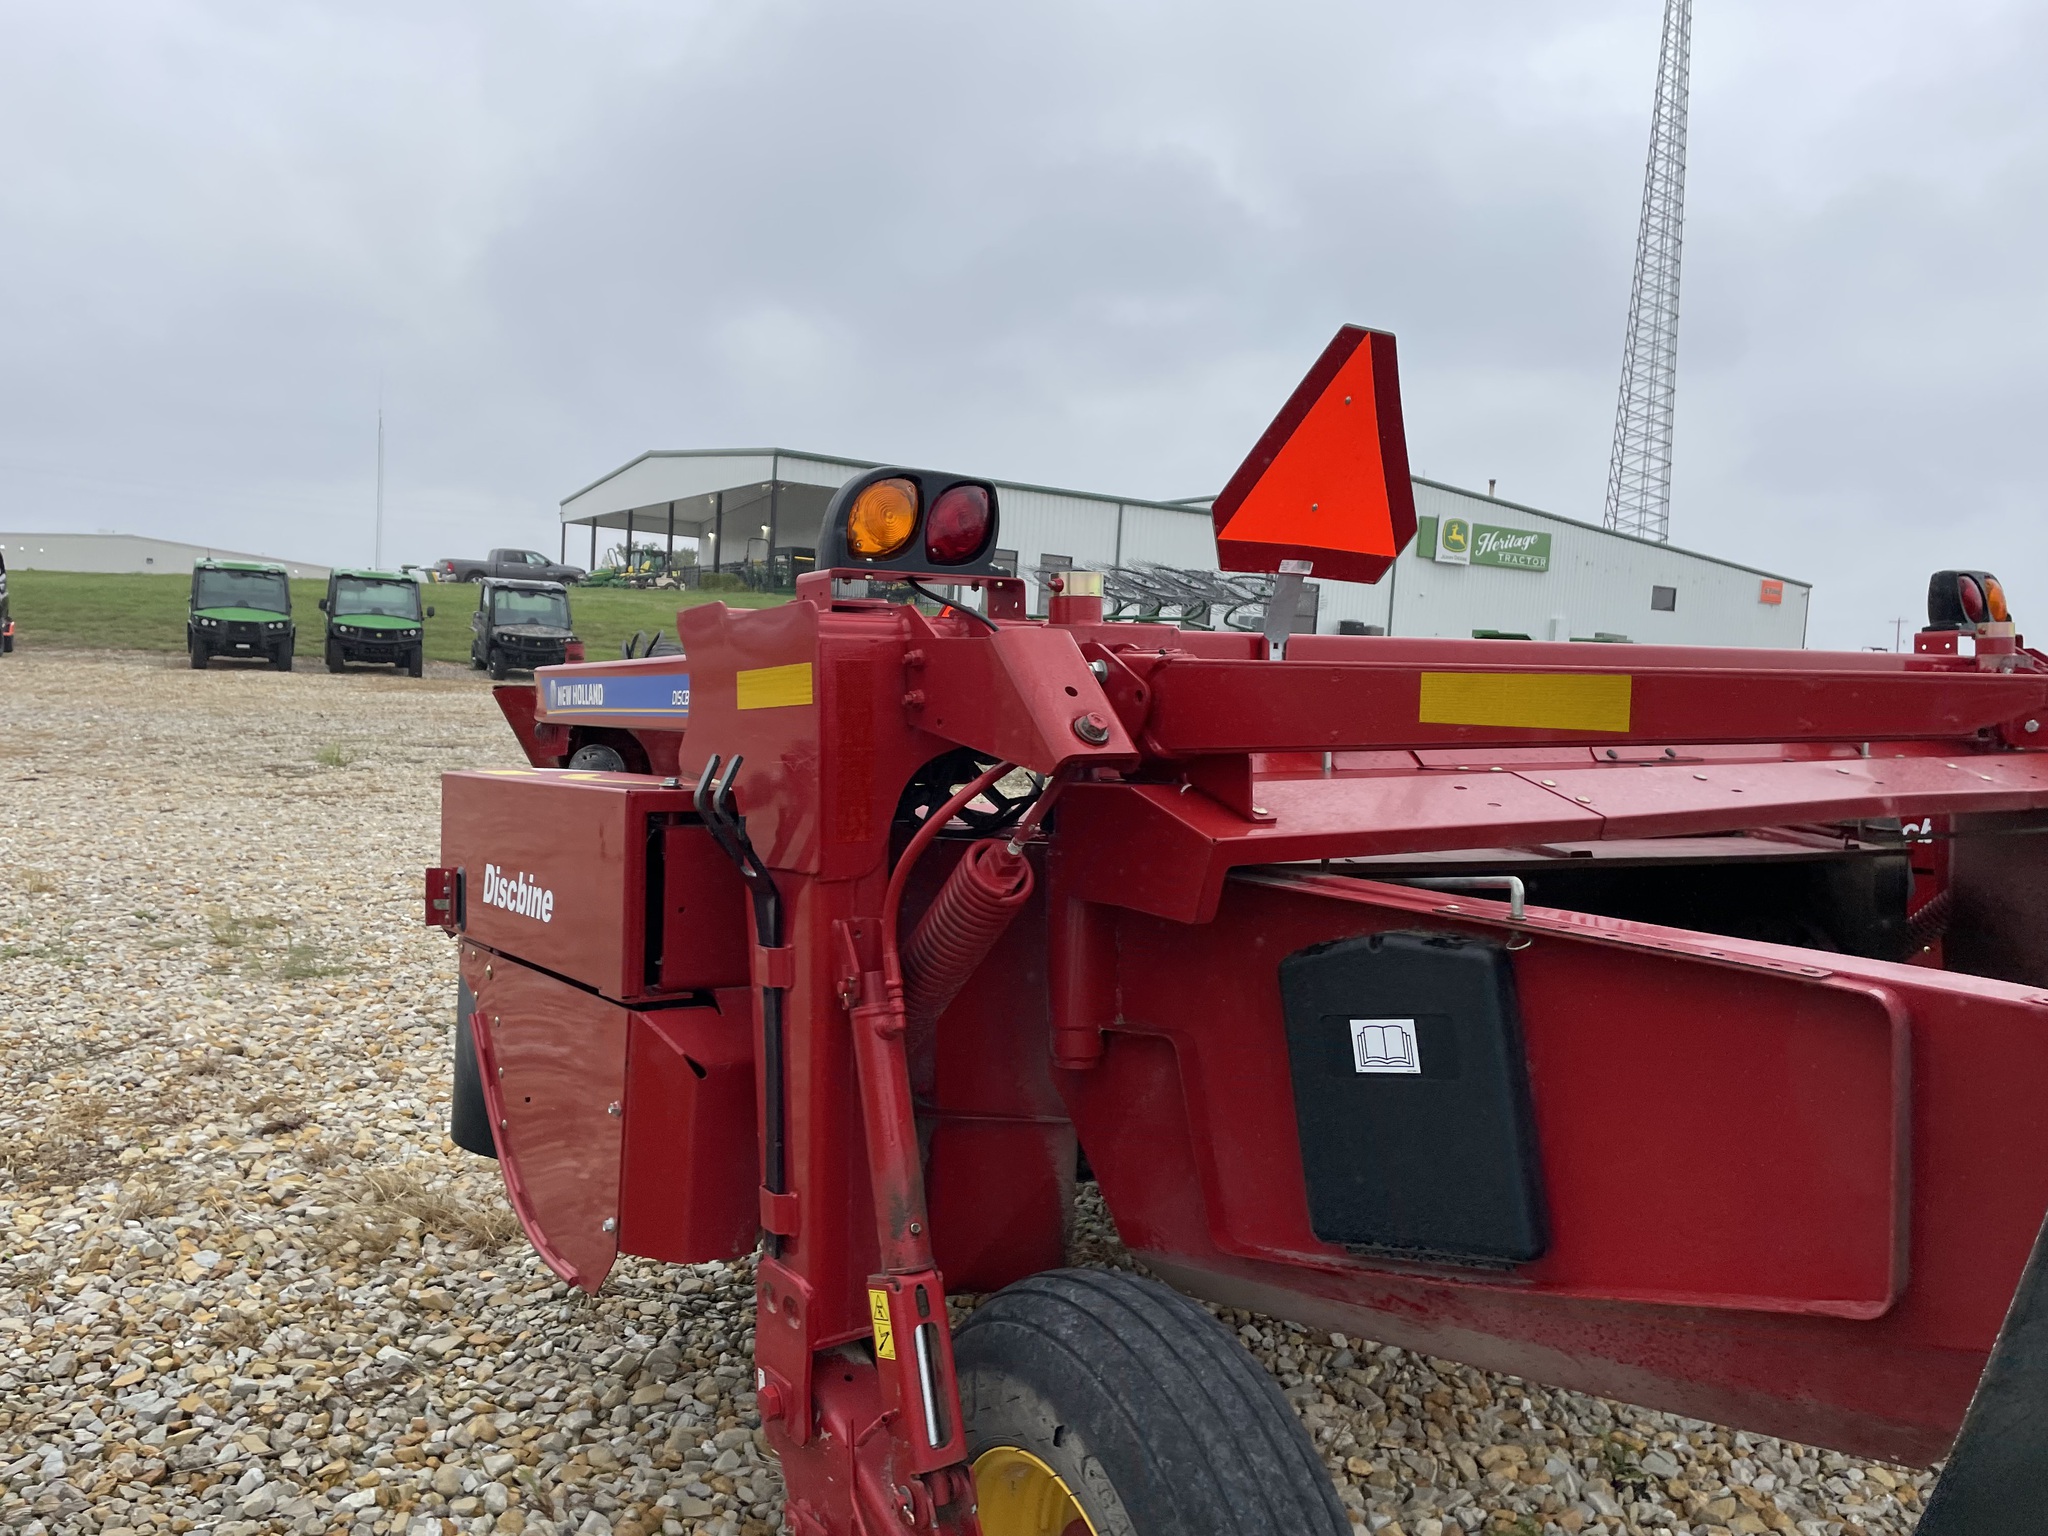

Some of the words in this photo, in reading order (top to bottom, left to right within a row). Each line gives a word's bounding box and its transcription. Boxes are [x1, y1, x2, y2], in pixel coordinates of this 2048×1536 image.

[1475, 531, 1538, 556] Heritage
[1499, 553, 1546, 567] TRACTOR
[557, 685, 572, 706] NEW
[572, 683, 604, 706] HOLLAND
[483, 863, 554, 923] Discbine
